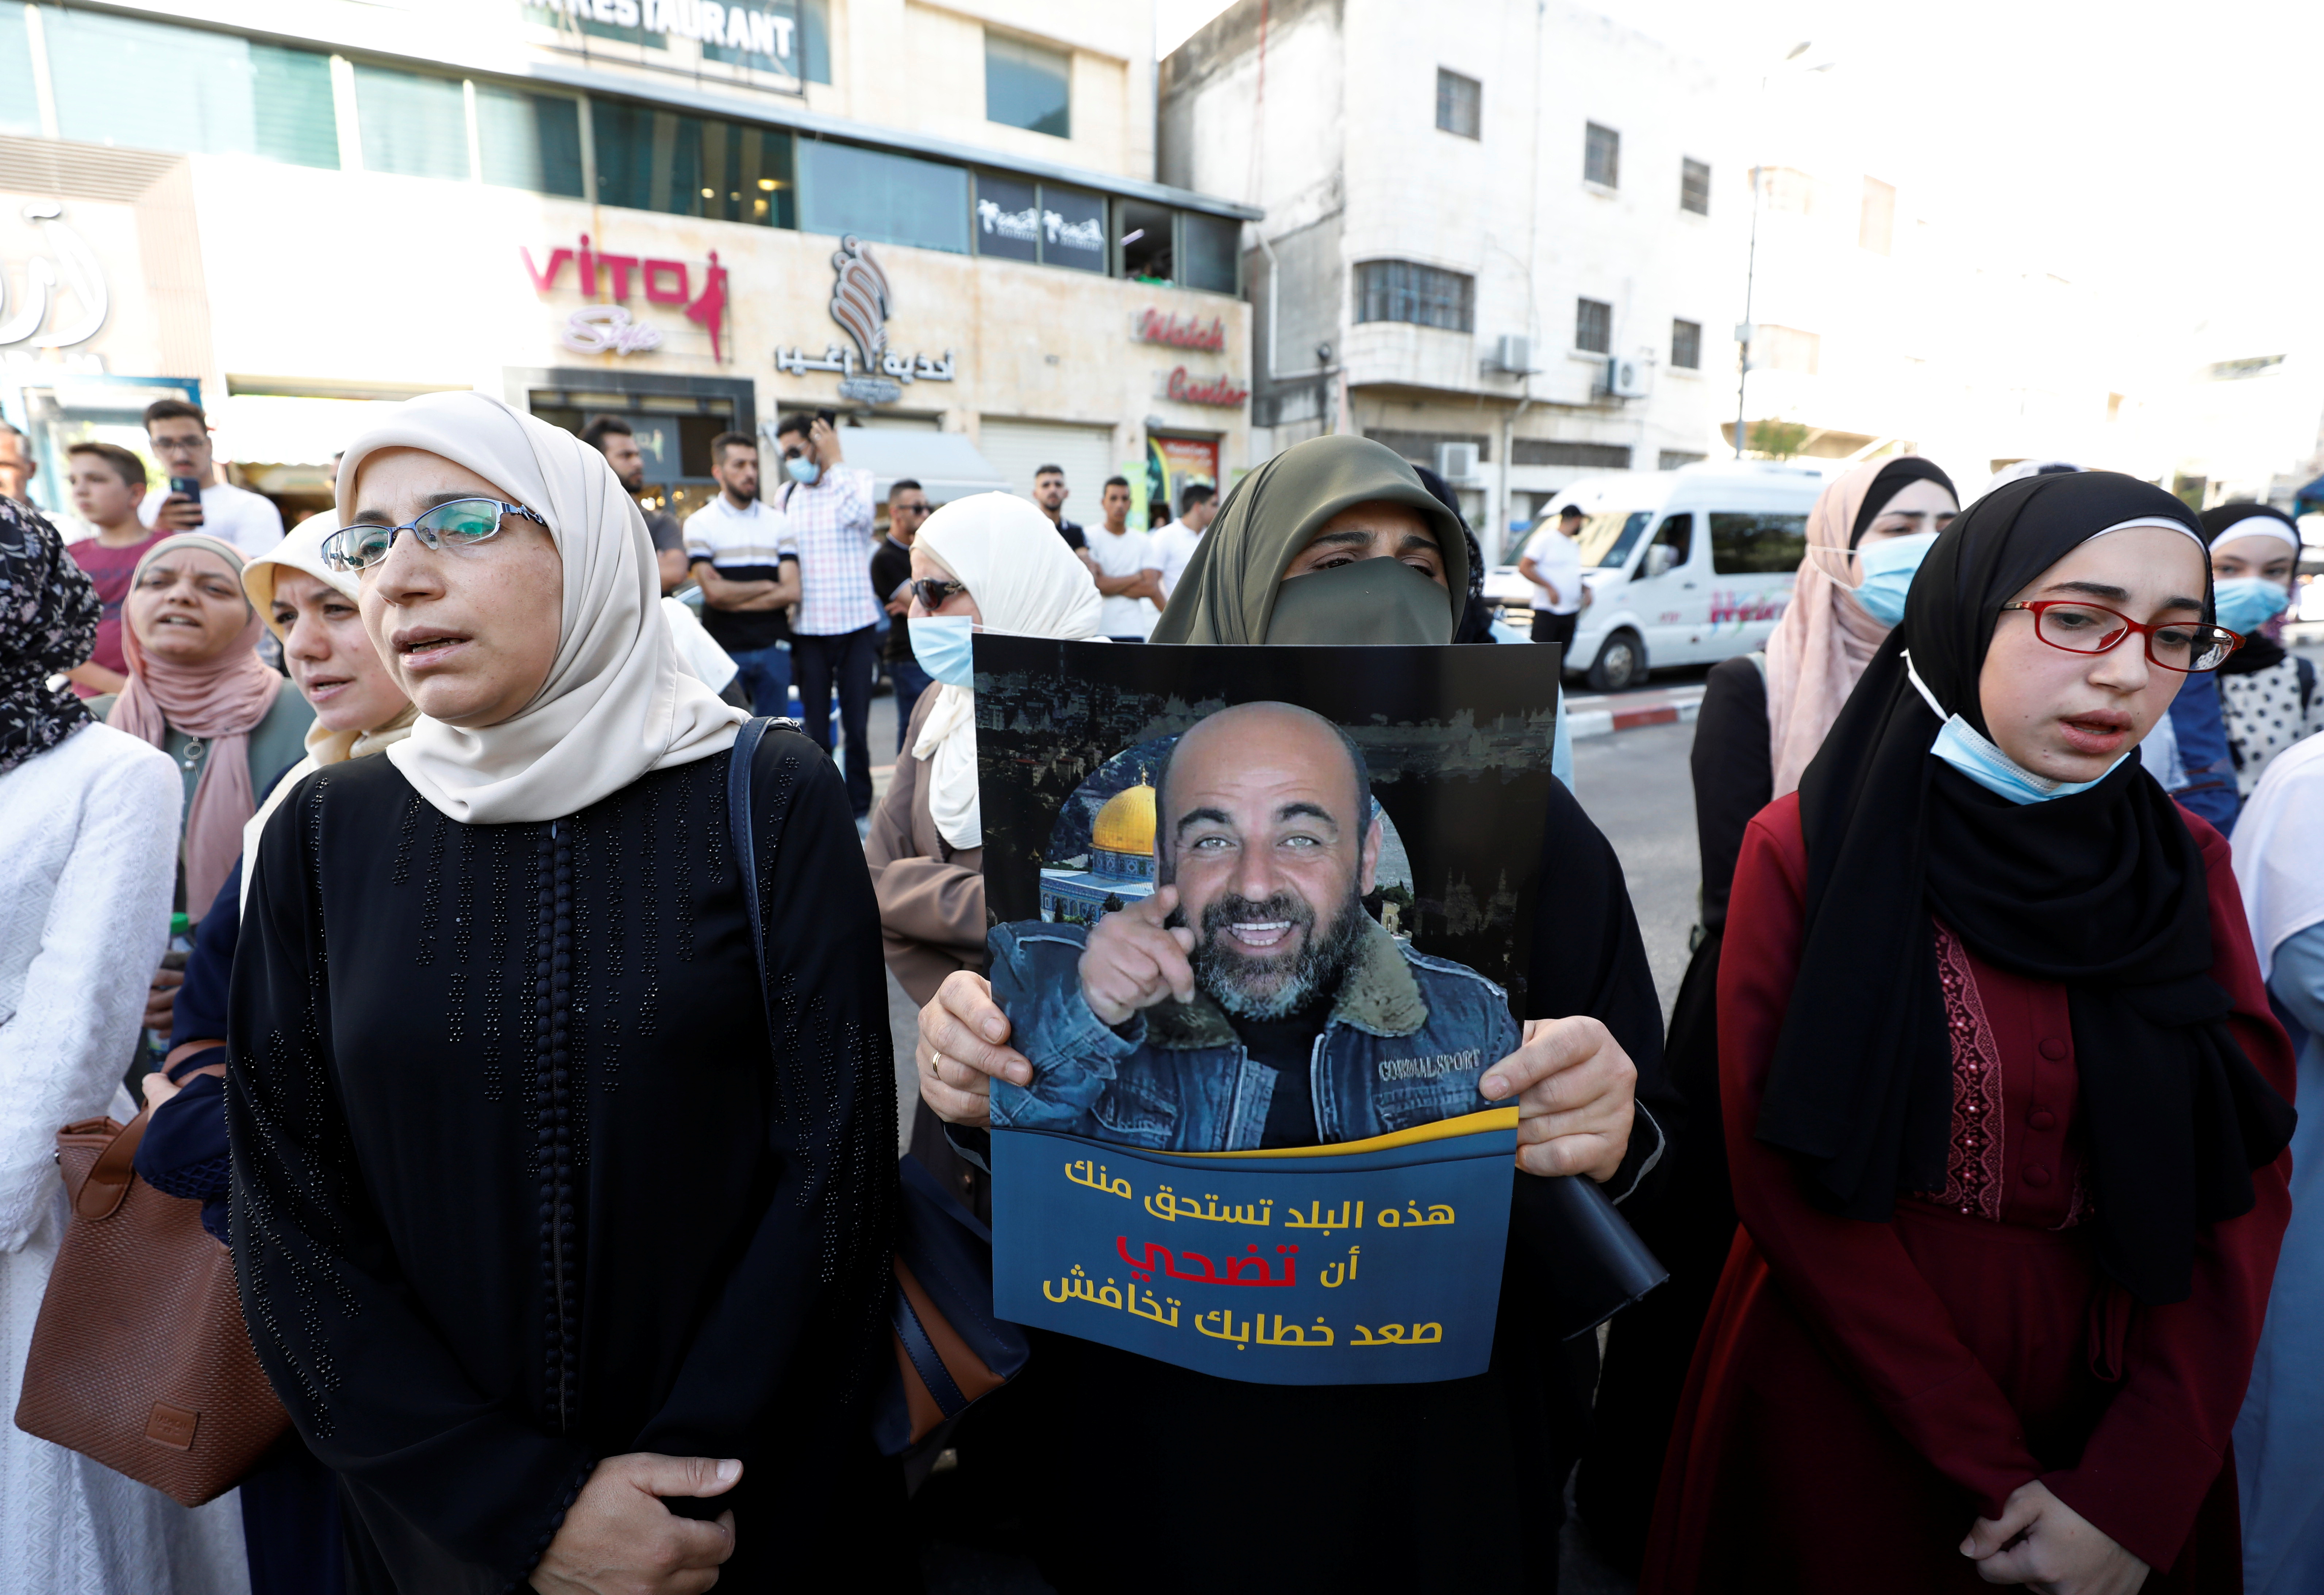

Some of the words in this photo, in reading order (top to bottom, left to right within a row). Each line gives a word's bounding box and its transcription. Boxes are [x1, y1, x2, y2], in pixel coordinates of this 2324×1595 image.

[1142, 307, 1224, 352] Watch
[882, 348, 955, 384] أحذية
[1167, 364, 1248, 405] Center
[1065, 1160, 1132, 1199] منك
[1144, 1185, 1274, 1225] تستحق
[1285, 1201, 1364, 1237] البلد
[1378, 1200, 1455, 1227] هذه
[1116, 1236, 1299, 1287] تضحي
[1320, 1246, 1360, 1288] أن
[1043, 1265, 1181, 1327] تخافش
[1194, 1310, 1335, 1350] خطابك
[1350, 1322, 1443, 1346] صعد
